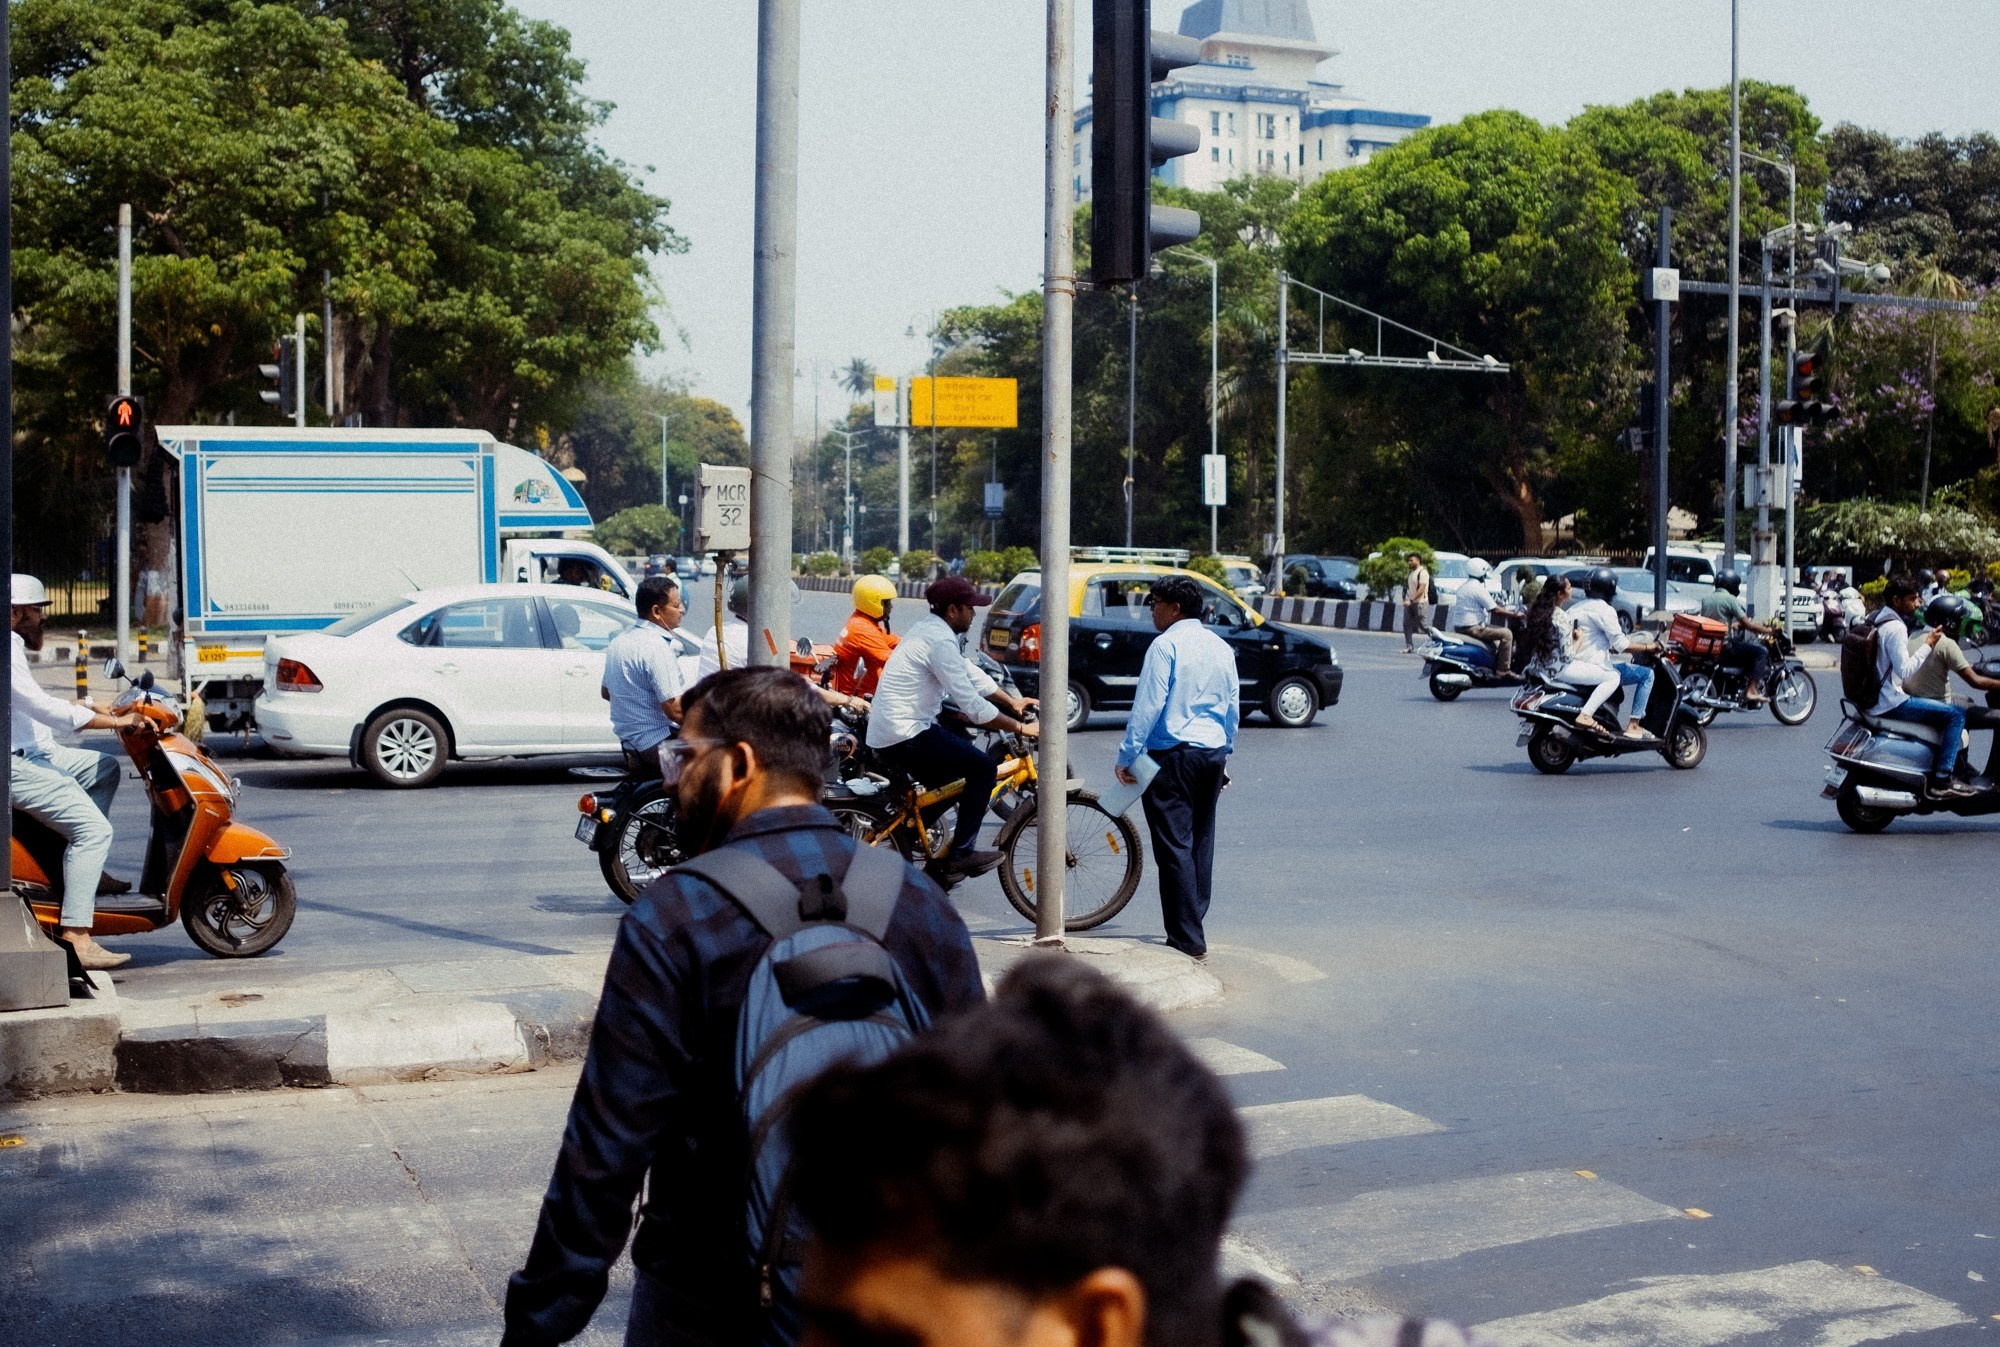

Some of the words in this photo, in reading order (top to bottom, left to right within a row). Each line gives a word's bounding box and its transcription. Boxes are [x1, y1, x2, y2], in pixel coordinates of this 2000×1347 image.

[925, 413, 967, 422] Ecourage
[717, 484, 747, 501] MCR
[719, 507, 742, 527] 32
